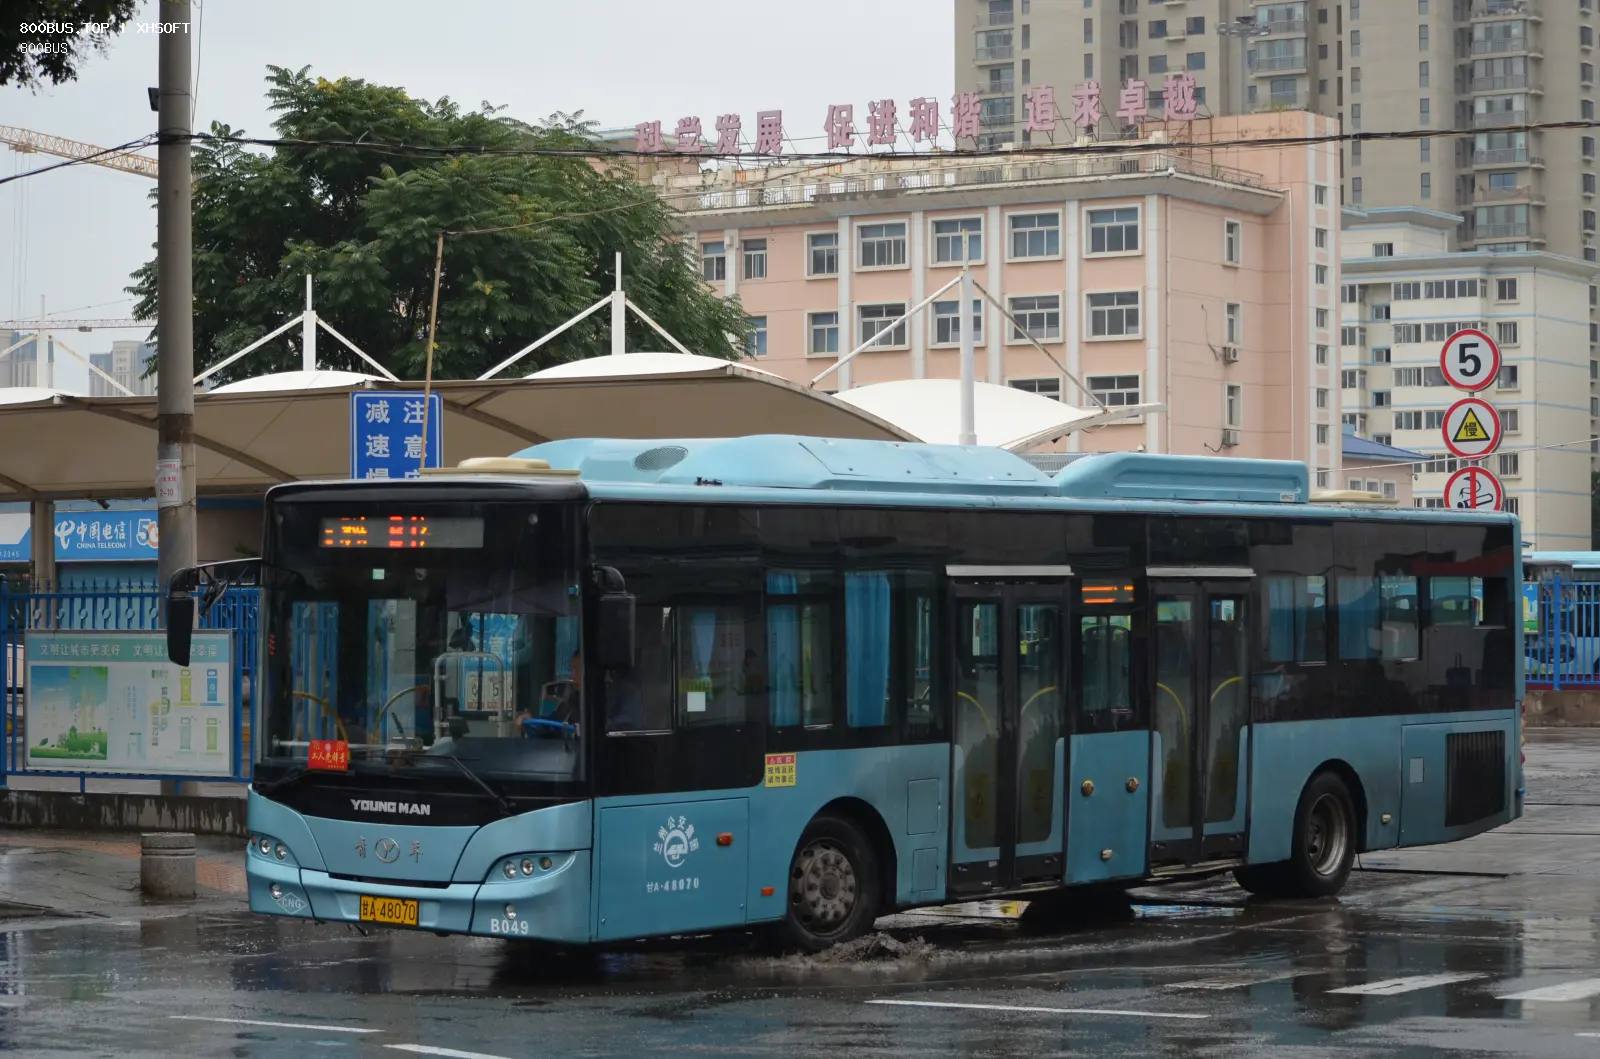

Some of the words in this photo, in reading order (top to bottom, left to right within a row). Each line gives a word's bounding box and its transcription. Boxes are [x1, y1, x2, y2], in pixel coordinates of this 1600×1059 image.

[634, 109, 784, 164] 科学发展
[823, 91, 983, 150] 促进和谐
[1025, 71, 1198, 132] 追求卓越
[1459, 342, 1482, 377] 5
[1464, 422, 1478, 437] 慢
[76, 520, 126, 542] 中国电信
[350, 799, 397, 813] YOUNG
[398, 802, 431, 816] MAN
[282, 898, 302, 909] CNG
[490, 918, 529, 935] B049
